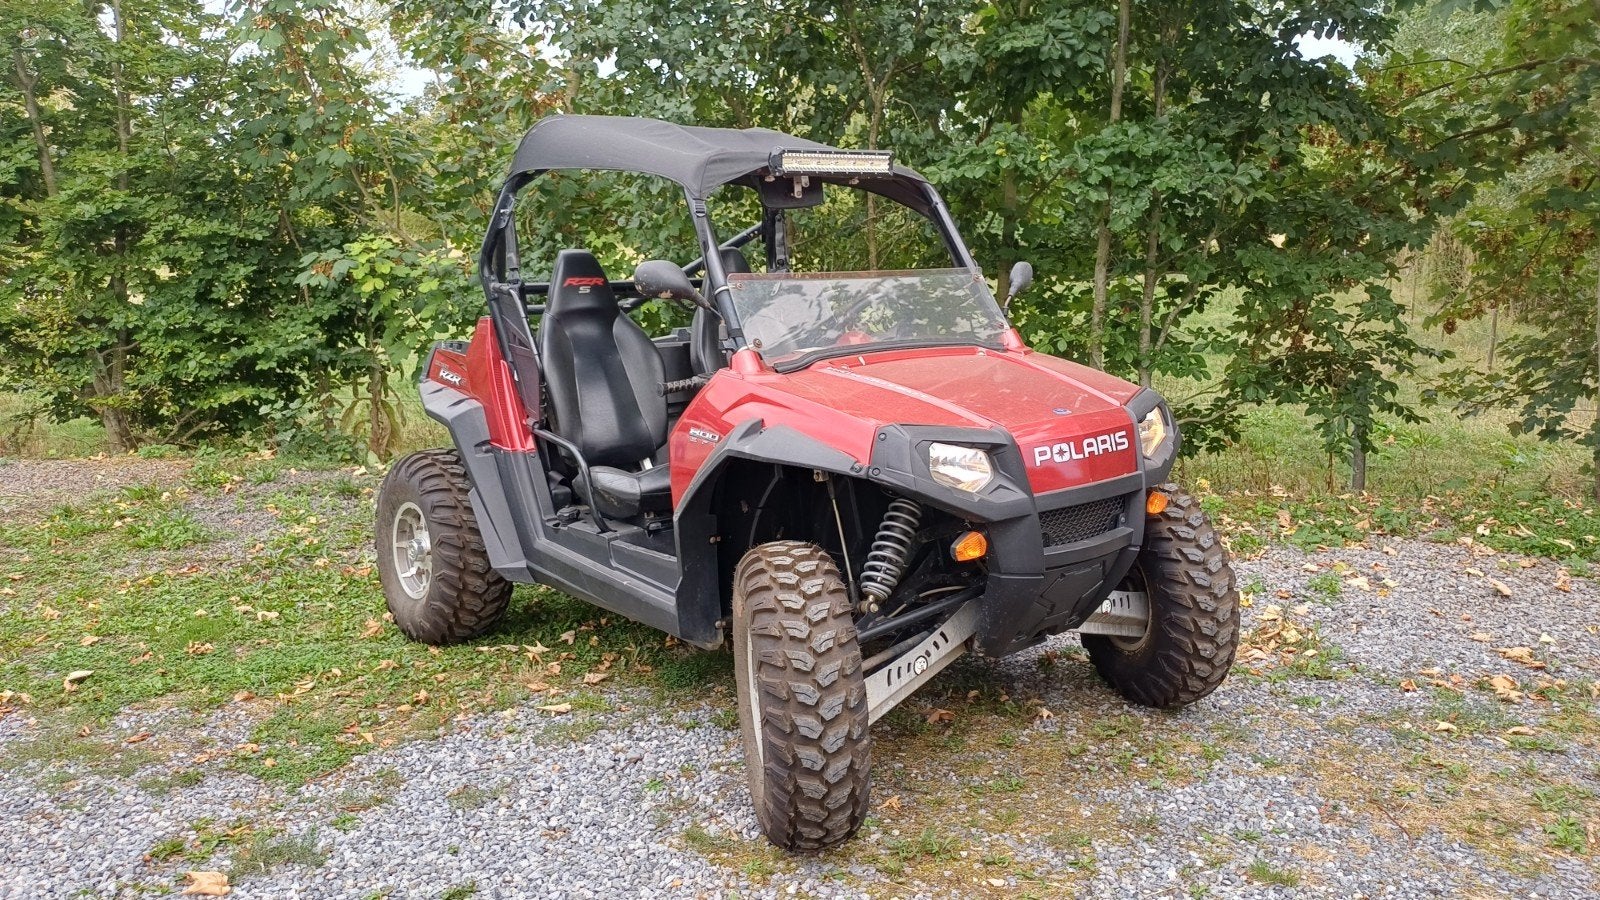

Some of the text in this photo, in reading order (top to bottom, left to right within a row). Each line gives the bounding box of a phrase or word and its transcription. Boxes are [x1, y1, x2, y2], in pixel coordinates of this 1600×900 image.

[563, 277, 604, 287] RZR
[439, 369, 462, 386] RZR
[1034, 430, 1129, 467] POLARIS
